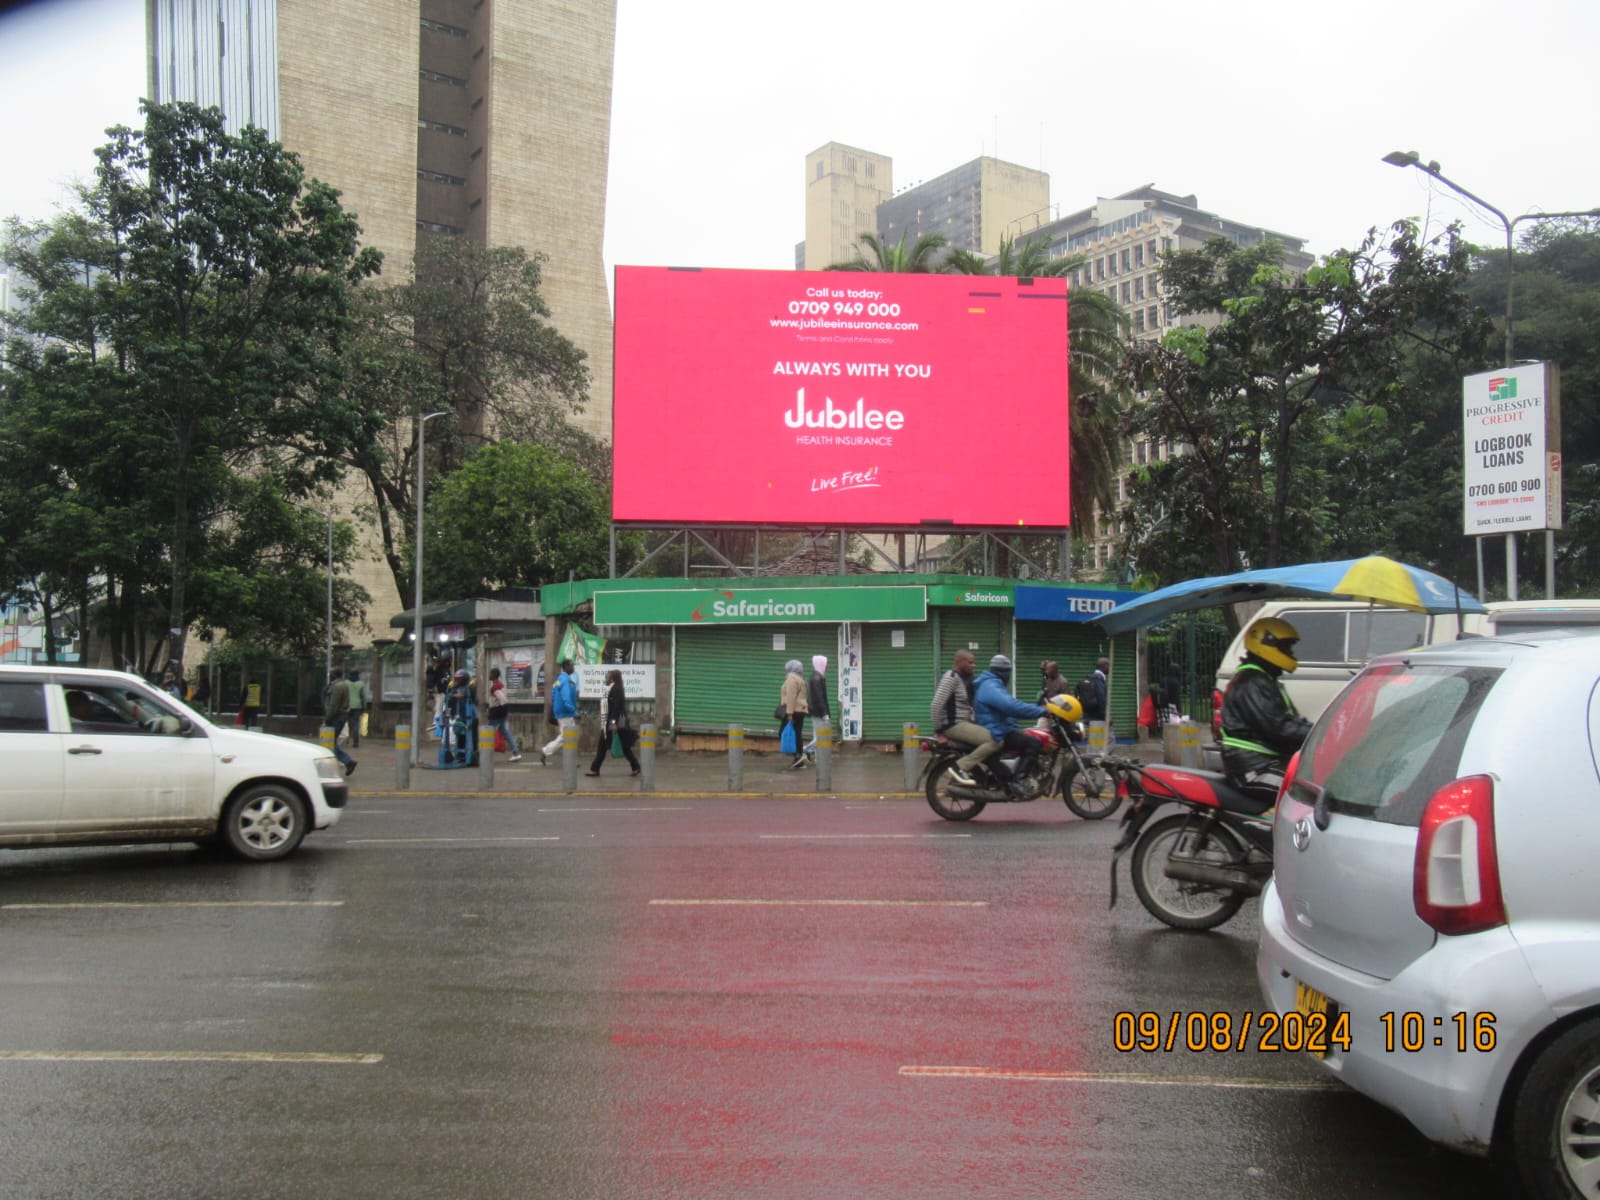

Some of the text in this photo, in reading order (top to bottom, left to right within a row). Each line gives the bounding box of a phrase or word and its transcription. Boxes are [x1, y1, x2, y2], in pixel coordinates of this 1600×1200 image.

[806, 288, 883, 300] Call us today:
[788, 301, 901, 316] 0709 949 000
[770, 317, 919, 331] www.jubileeinsurance.com
[773, 361, 932, 378] ALWAYS WITH YOU
[784, 386, 905, 430] Jubilee
[1466, 397, 1542, 418] PROGRESSIVE
[1482, 410, 1524, 426] CREDIT
[796, 436, 893, 446] HEALTH INSURANCE
[1474, 432, 1532, 454] LOGBOOK
[1483, 450, 1524, 469] LOANS
[811, 466, 879, 492] Live Free!
[1468, 478, 1541, 497] 0700 600 900
[964, 592, 1008, 603] Safaricom
[712, 598, 816, 617] Safaricom
